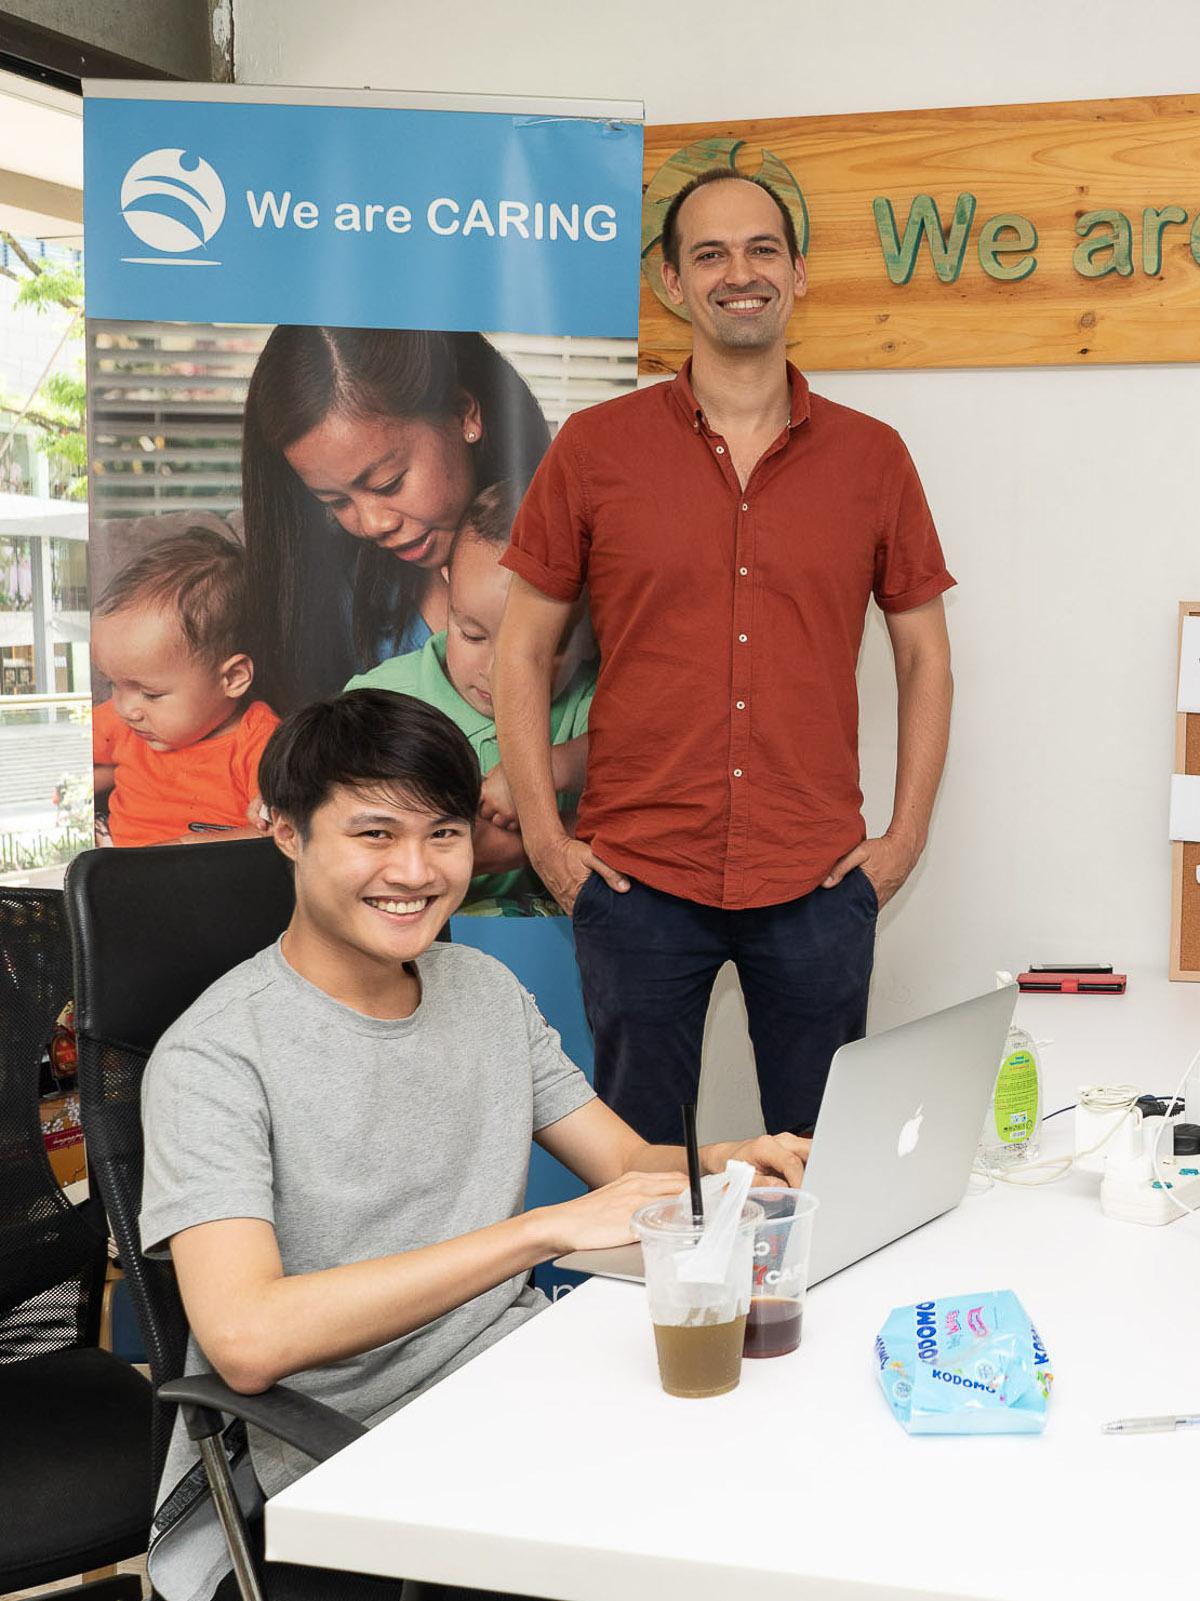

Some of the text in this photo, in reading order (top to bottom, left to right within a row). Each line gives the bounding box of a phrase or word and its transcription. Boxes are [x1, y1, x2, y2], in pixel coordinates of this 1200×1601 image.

[246, 190, 618, 242] We are CARING
[871, 192, 1039, 286] We
[916, 1301, 938, 1364] ODOMO
[932, 1369, 997, 1394] KODOMO
